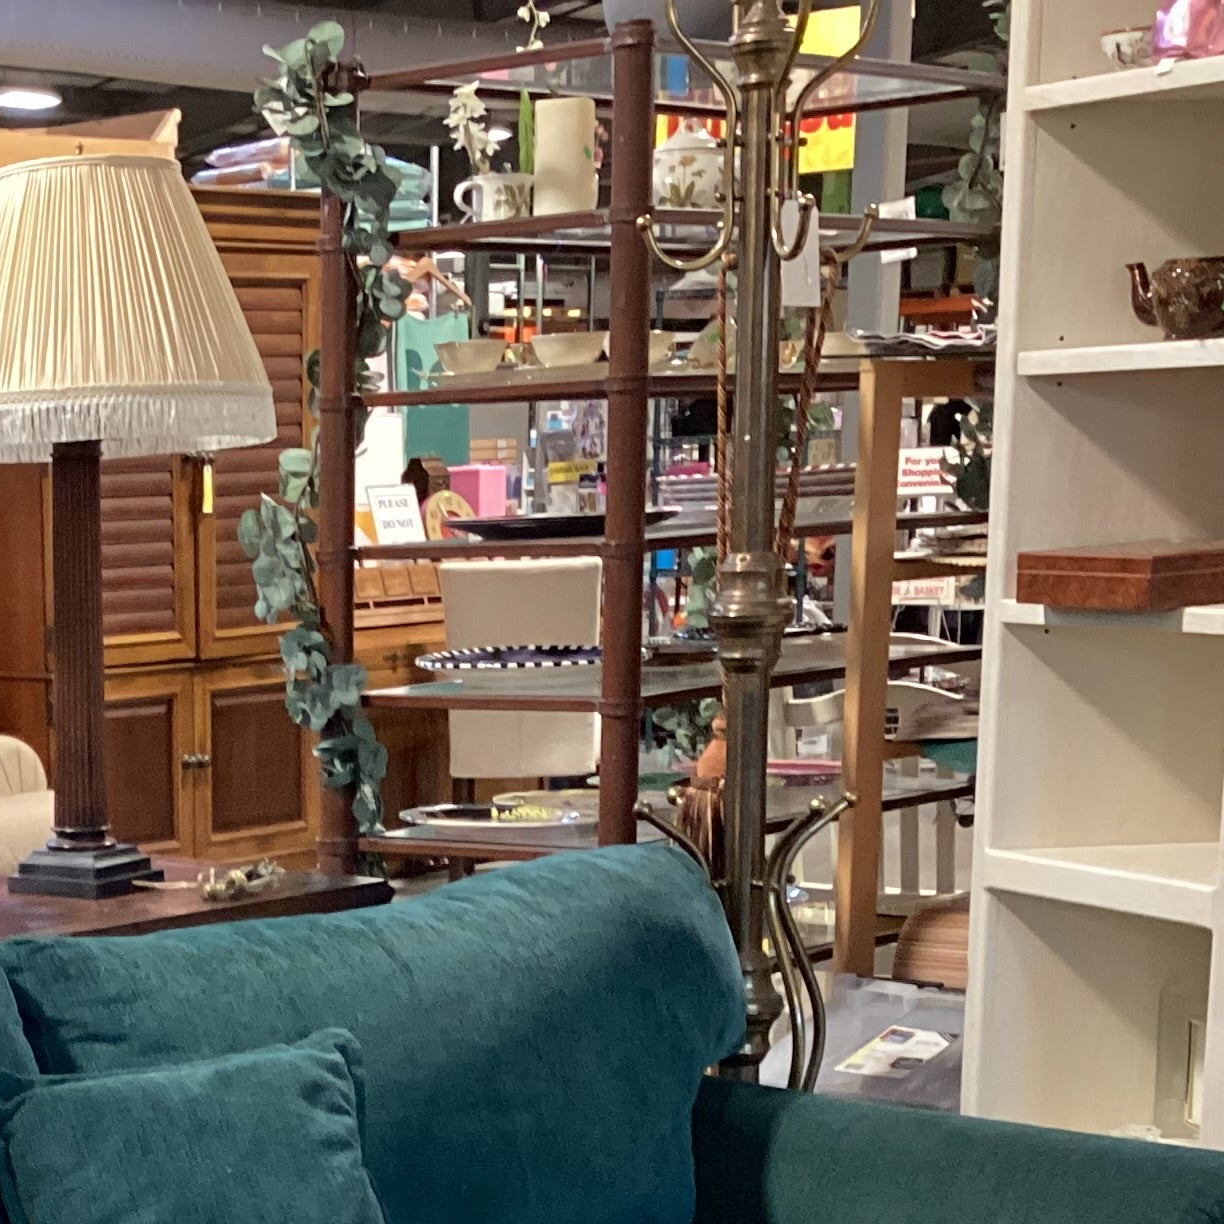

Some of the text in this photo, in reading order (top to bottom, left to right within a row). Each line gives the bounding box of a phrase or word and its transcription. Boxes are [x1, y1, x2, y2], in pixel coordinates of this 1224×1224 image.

[378, 498, 409, 509] PLEASE
[382, 518, 414, 530] DO NOT
